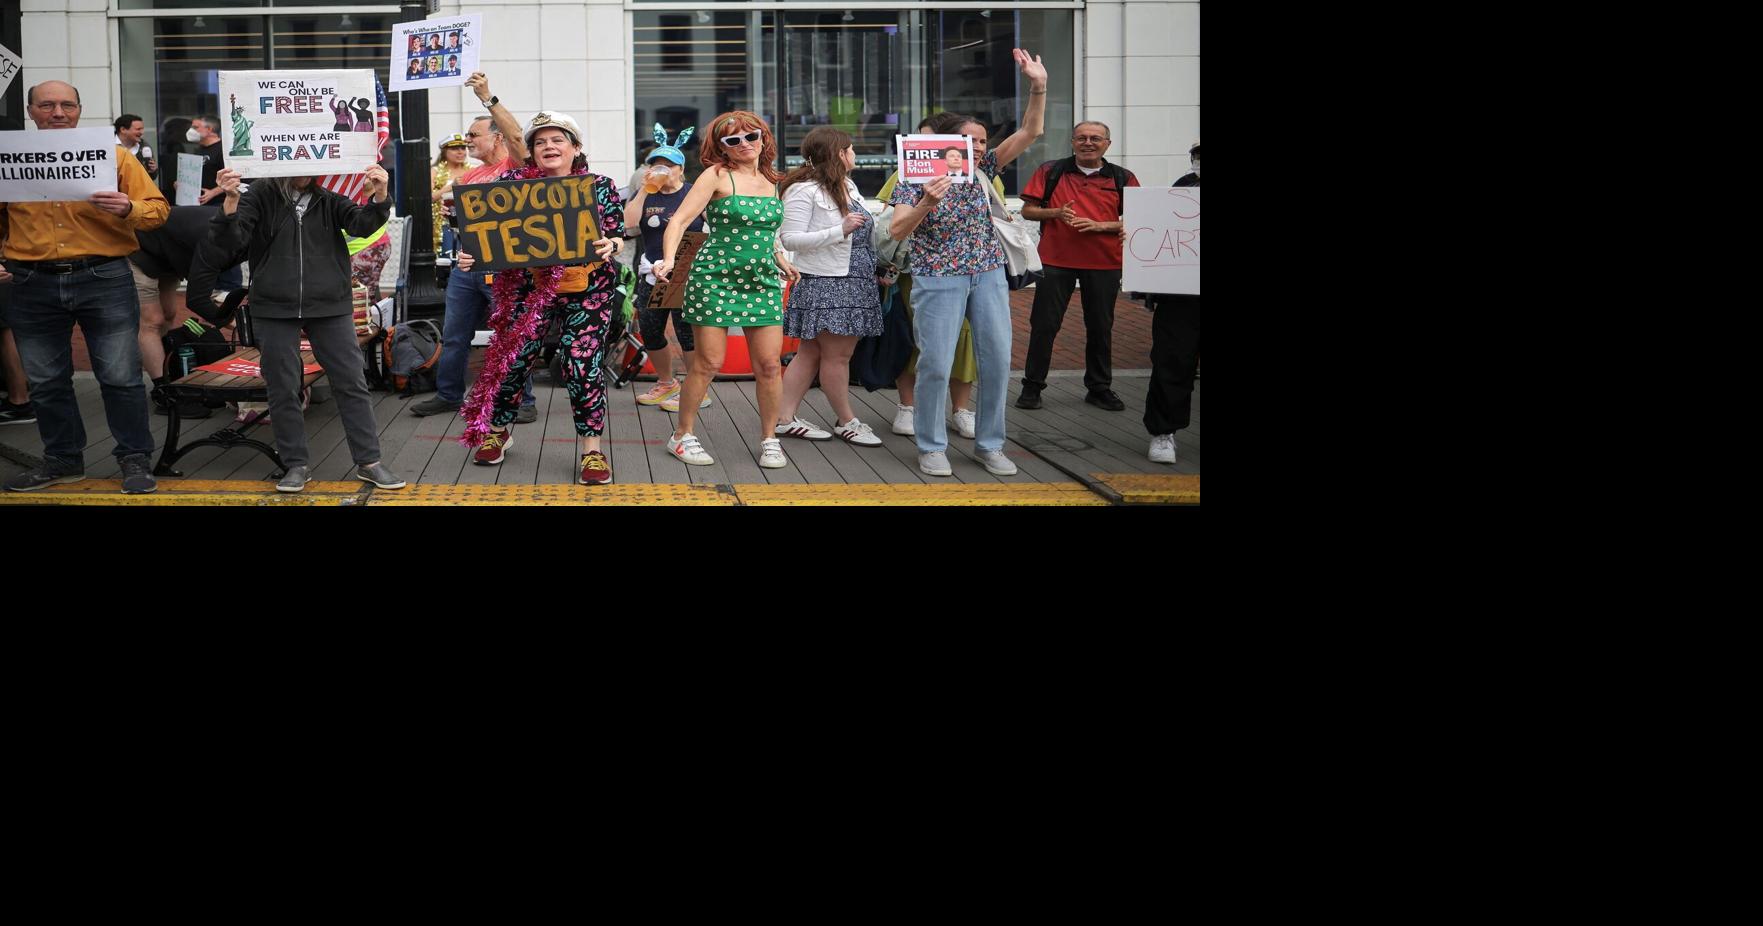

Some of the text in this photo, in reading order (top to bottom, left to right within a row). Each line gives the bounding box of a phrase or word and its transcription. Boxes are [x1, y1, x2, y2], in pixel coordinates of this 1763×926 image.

[0, 53, 18, 79] SE
[258, 81, 304, 89] WE CAN
[289, 88, 318, 96] ONLY
[260, 95, 323, 115] FREE
[261, 133, 340, 142] WHEN WE ARE
[61, 149, 107, 162] OVER
[262, 144, 340, 161] BRAVE
[906, 149, 940, 160] FIRE
[0, 165, 96, 180] LLIONAIRES!
[907, 166, 935, 174] Musk
[461, 176, 594, 220] BOYCOTT
[464, 209, 600, 263] TESLA
